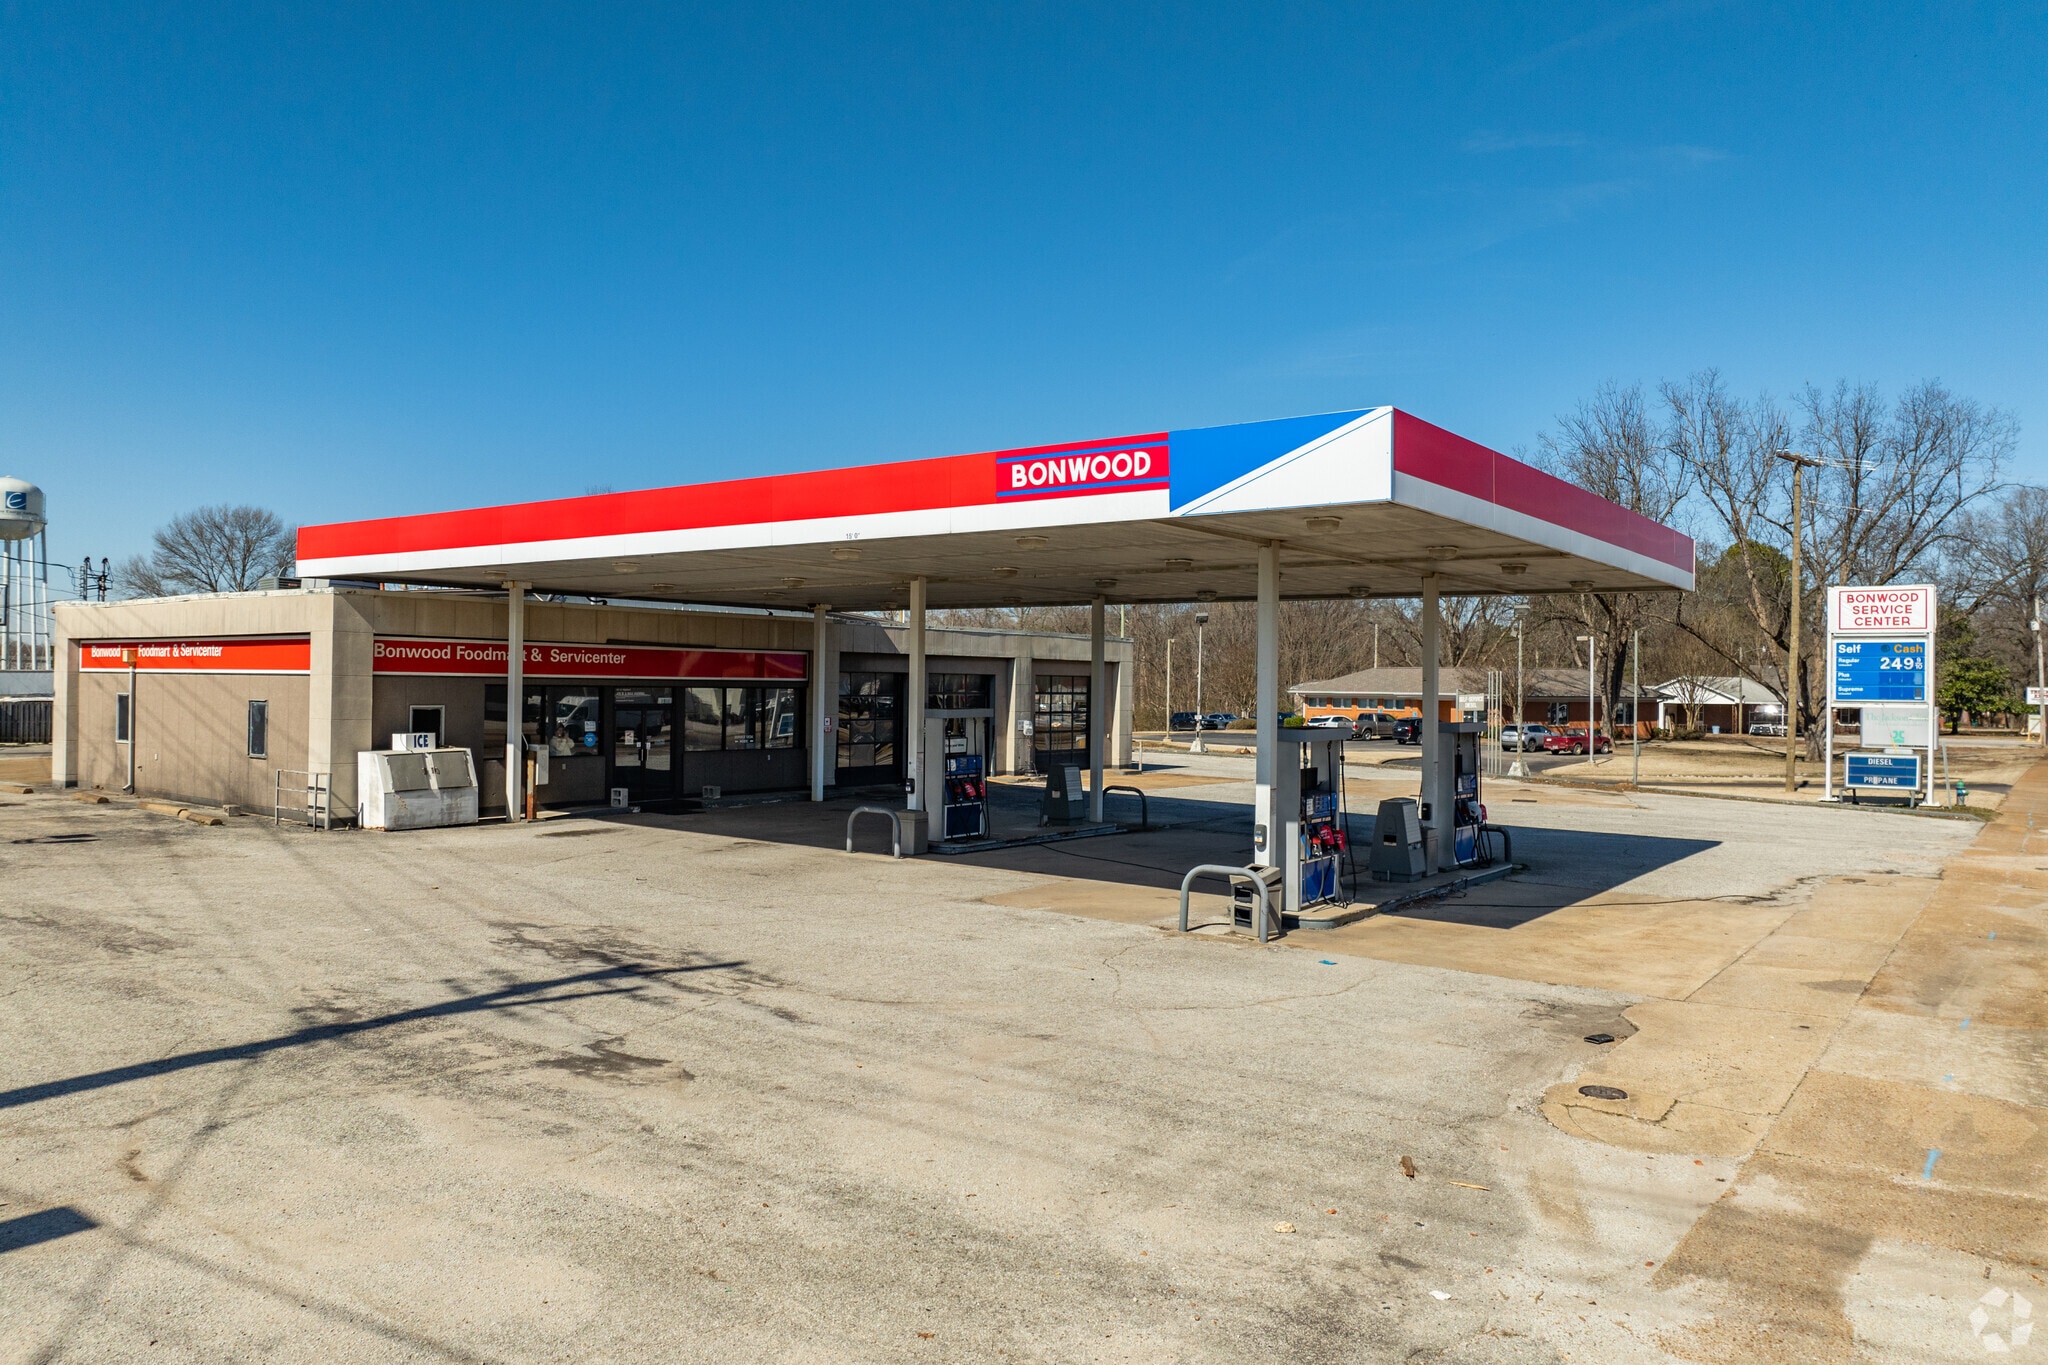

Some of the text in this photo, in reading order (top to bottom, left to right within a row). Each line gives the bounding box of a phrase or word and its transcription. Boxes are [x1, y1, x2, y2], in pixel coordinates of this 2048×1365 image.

[1011, 451, 1151, 488] BONWOOD
[1847, 593, 1919, 603] BONWOOD
[1852, 605, 1912, 614] SERVICE
[1854, 616, 1911, 626] CENTER
[91, 642, 223, 657] Bonwood Foodmart & Servicenter
[374, 643, 626, 664] Bonwood Foodmt & Servicenter
[1838, 644, 1923, 653] Self Cash
[413, 735, 428, 748] ICE
